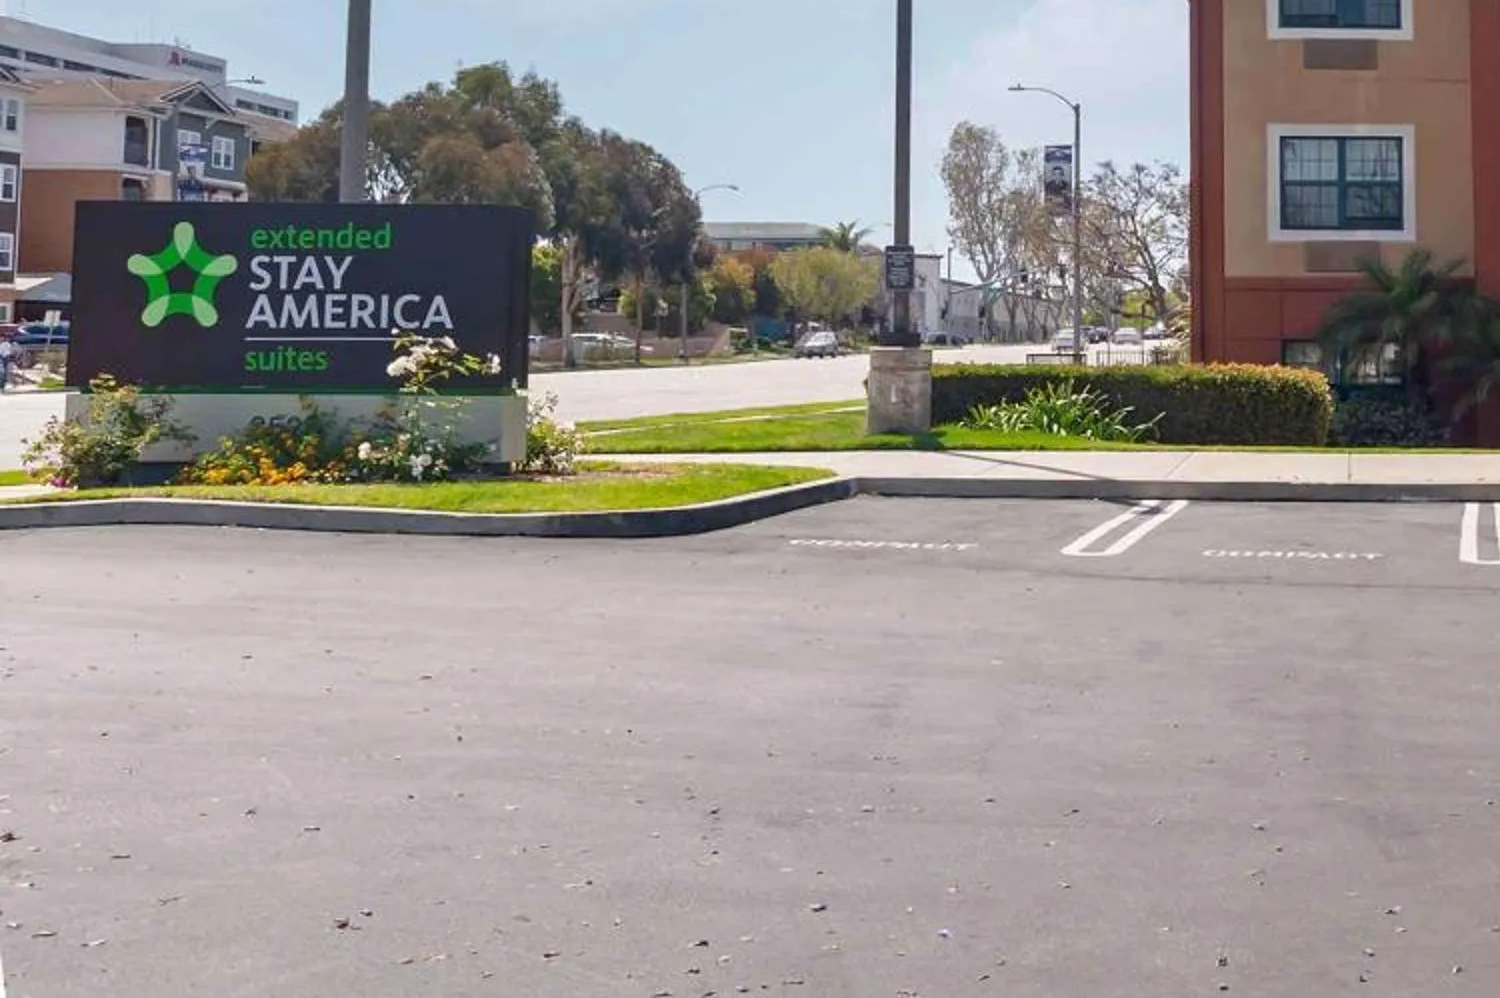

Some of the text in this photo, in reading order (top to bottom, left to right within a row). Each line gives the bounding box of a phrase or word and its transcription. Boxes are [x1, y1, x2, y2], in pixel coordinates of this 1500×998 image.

[251, 222, 391, 249] extended
[249, 256, 354, 290] STAY
[245, 294, 453, 329] AMERICA
[244, 345, 329, 372] suites
